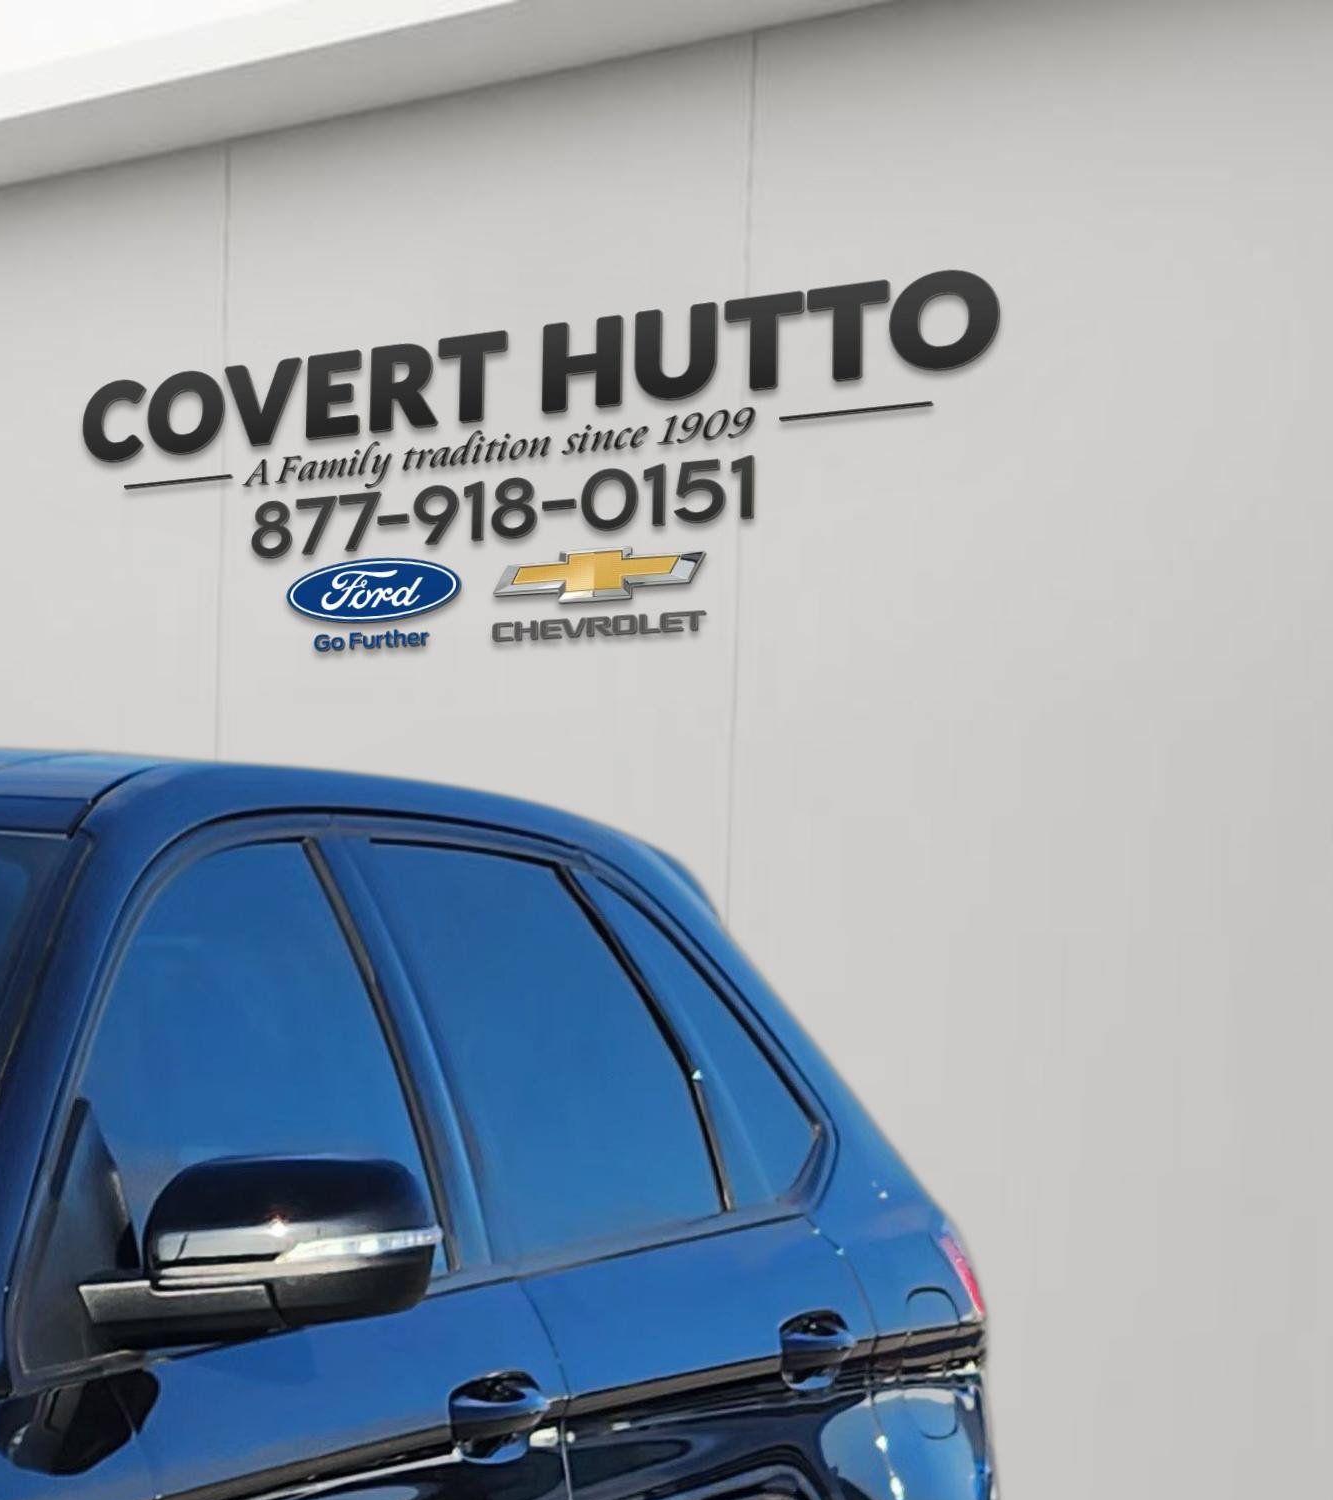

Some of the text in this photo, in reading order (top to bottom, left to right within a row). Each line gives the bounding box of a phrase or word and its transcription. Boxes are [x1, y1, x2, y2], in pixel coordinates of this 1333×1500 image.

[82, 270, 1001, 463] COVERT HUTTO
[242, 406, 756, 489] A Family tradition since 1909
[251, 454, 755, 558] 877-918-0151
[321, 570, 423, 610] Ford
[314, 629, 430, 652] Go Further
[491, 610, 707, 643] CHEVROLET
